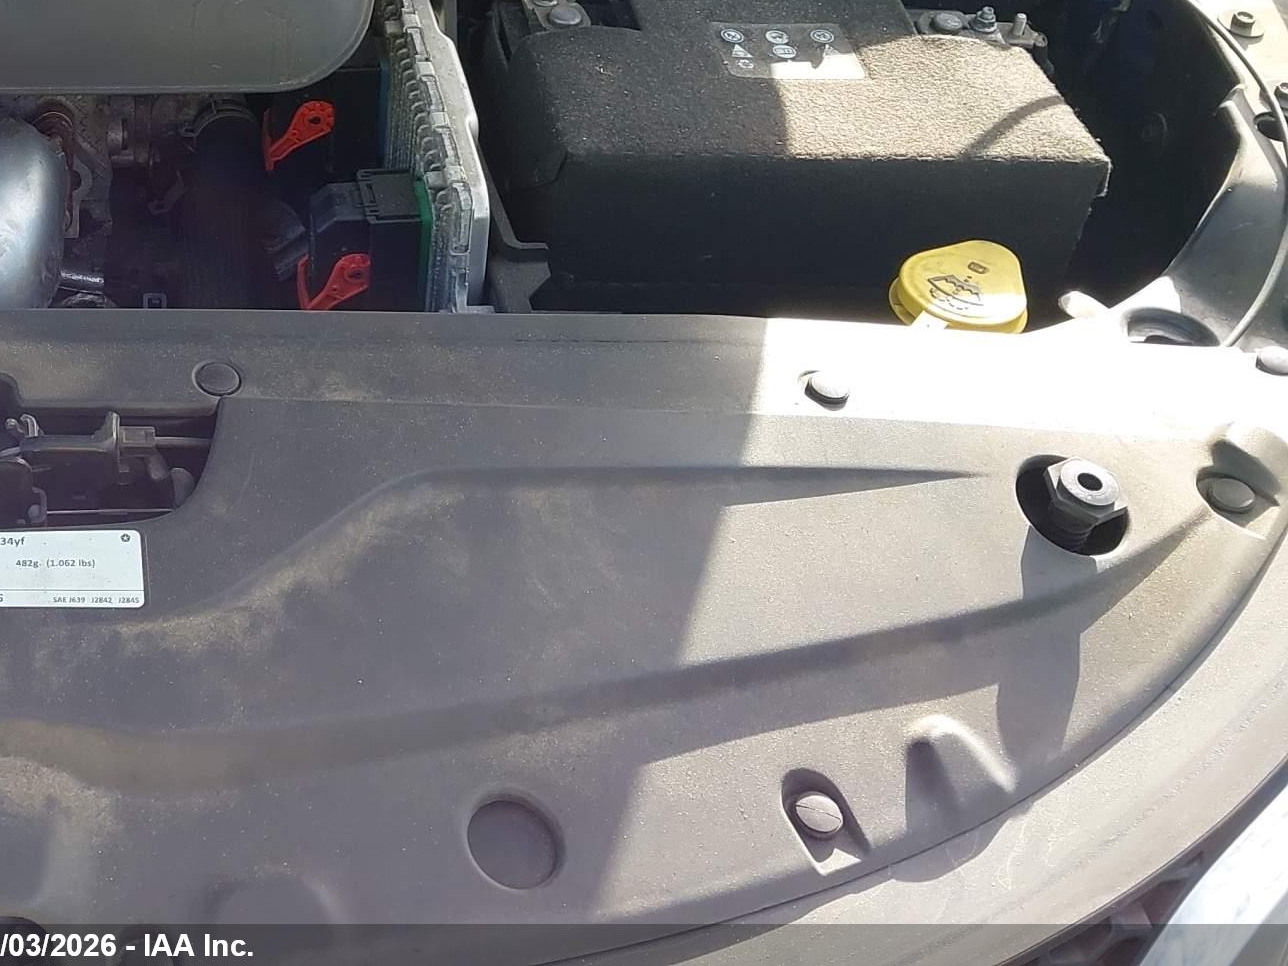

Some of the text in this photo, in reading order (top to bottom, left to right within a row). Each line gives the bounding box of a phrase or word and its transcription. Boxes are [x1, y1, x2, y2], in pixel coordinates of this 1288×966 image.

[46, 559, 75, 568] (1.062
[78, 559, 95, 568] lbs)
[53, 596, 67, 604] SAE
[69, 596, 86, 604] J639
